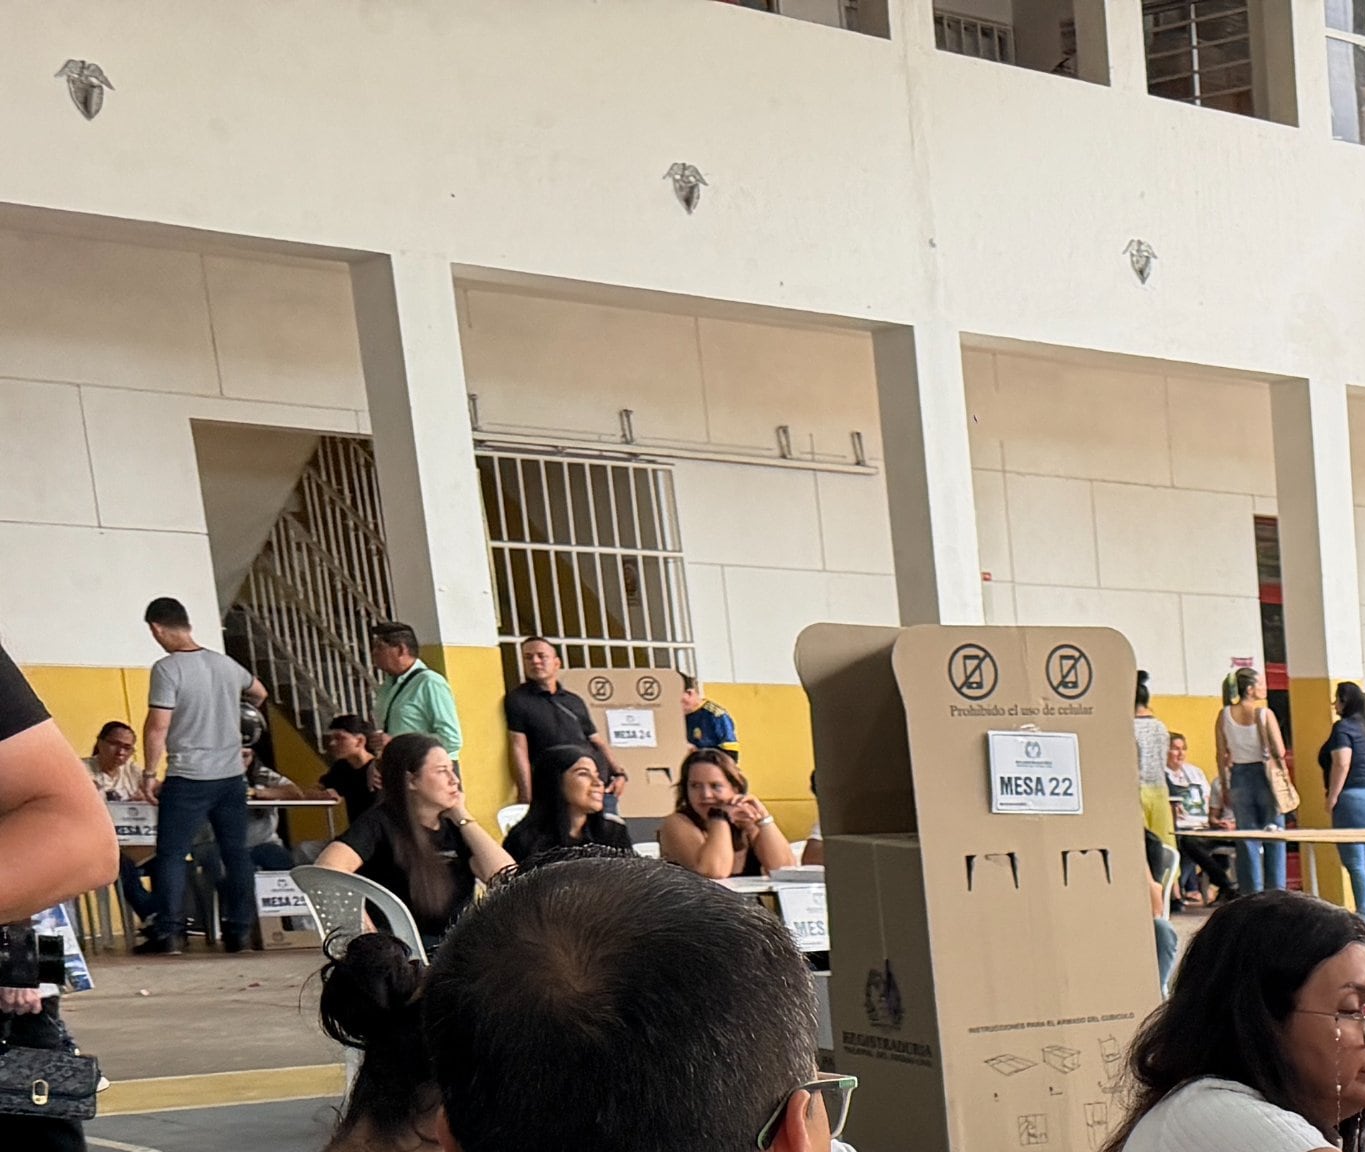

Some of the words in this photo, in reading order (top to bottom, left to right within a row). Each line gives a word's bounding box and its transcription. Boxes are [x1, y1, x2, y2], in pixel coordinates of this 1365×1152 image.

[950, 705, 1005, 717] Prohibido
[1008, 704, 1018, 716] el
[1021, 707, 1040, 716] uso
[1043, 704, 1055, 716] de
[1058, 704, 1093, 716] celular
[1000, 776, 1046, 796] MESA
[1049, 777, 1073, 796] 22
[794, 920, 825, 936] MES
